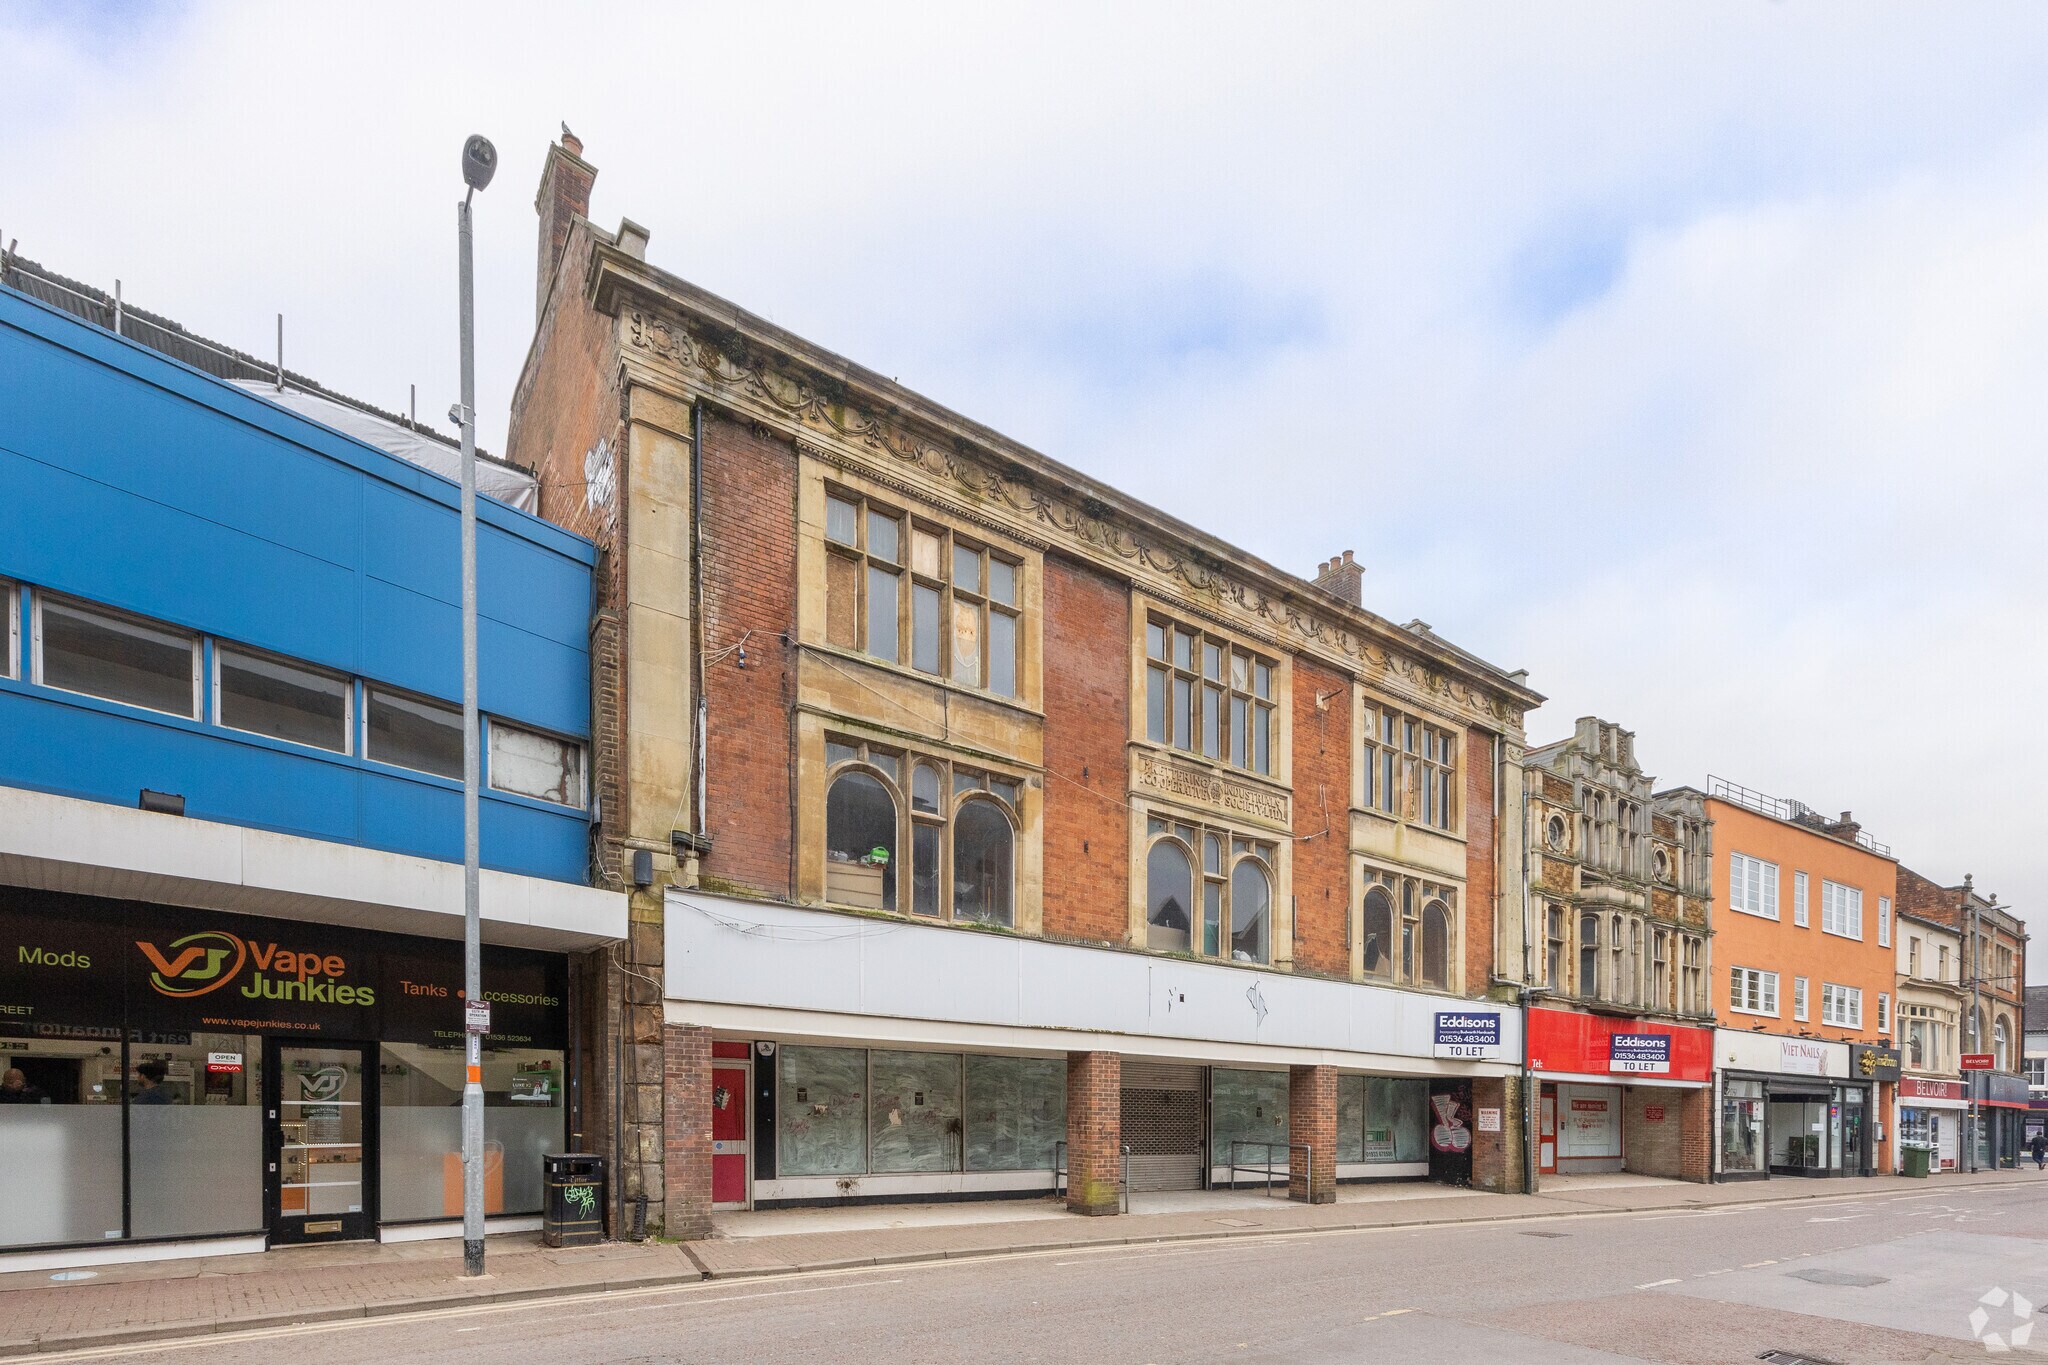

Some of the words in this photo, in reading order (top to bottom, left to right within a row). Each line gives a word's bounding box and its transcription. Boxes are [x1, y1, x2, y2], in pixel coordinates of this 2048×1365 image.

[18, 945, 91, 969] Mods
[248, 940, 346, 982] Vape
[241, 972, 375, 1006] Junkies
[400, 980, 448, 998] Tanks
[480, 990, 559, 1007] ccessories
[202, 1016, 321, 1030] www.vapejunkies.co.uk
[1439, 1015, 1496, 1028] Eddisons
[485, 1034, 506, 1042] 01536
[1439, 1035, 1462, 1043] 01536
[1463, 1035, 1496, 1044] 483400
[1615, 1035, 1666, 1048] Eddisons
[1449, 1046, 1462, 1056] TO
[1466, 1046, 1484, 1056] LET
[1614, 1052, 1635, 1060] 01536
[1636, 1053, 1666, 1061] 483400
[1782, 1041, 1799, 1057] VIET
[1799, 1044, 1820, 1059] NAILS
[1532, 1059, 1543, 1068] Tel:
[1624, 1062, 1635, 1070] TO
[1639, 1062, 1655, 1071] LET
